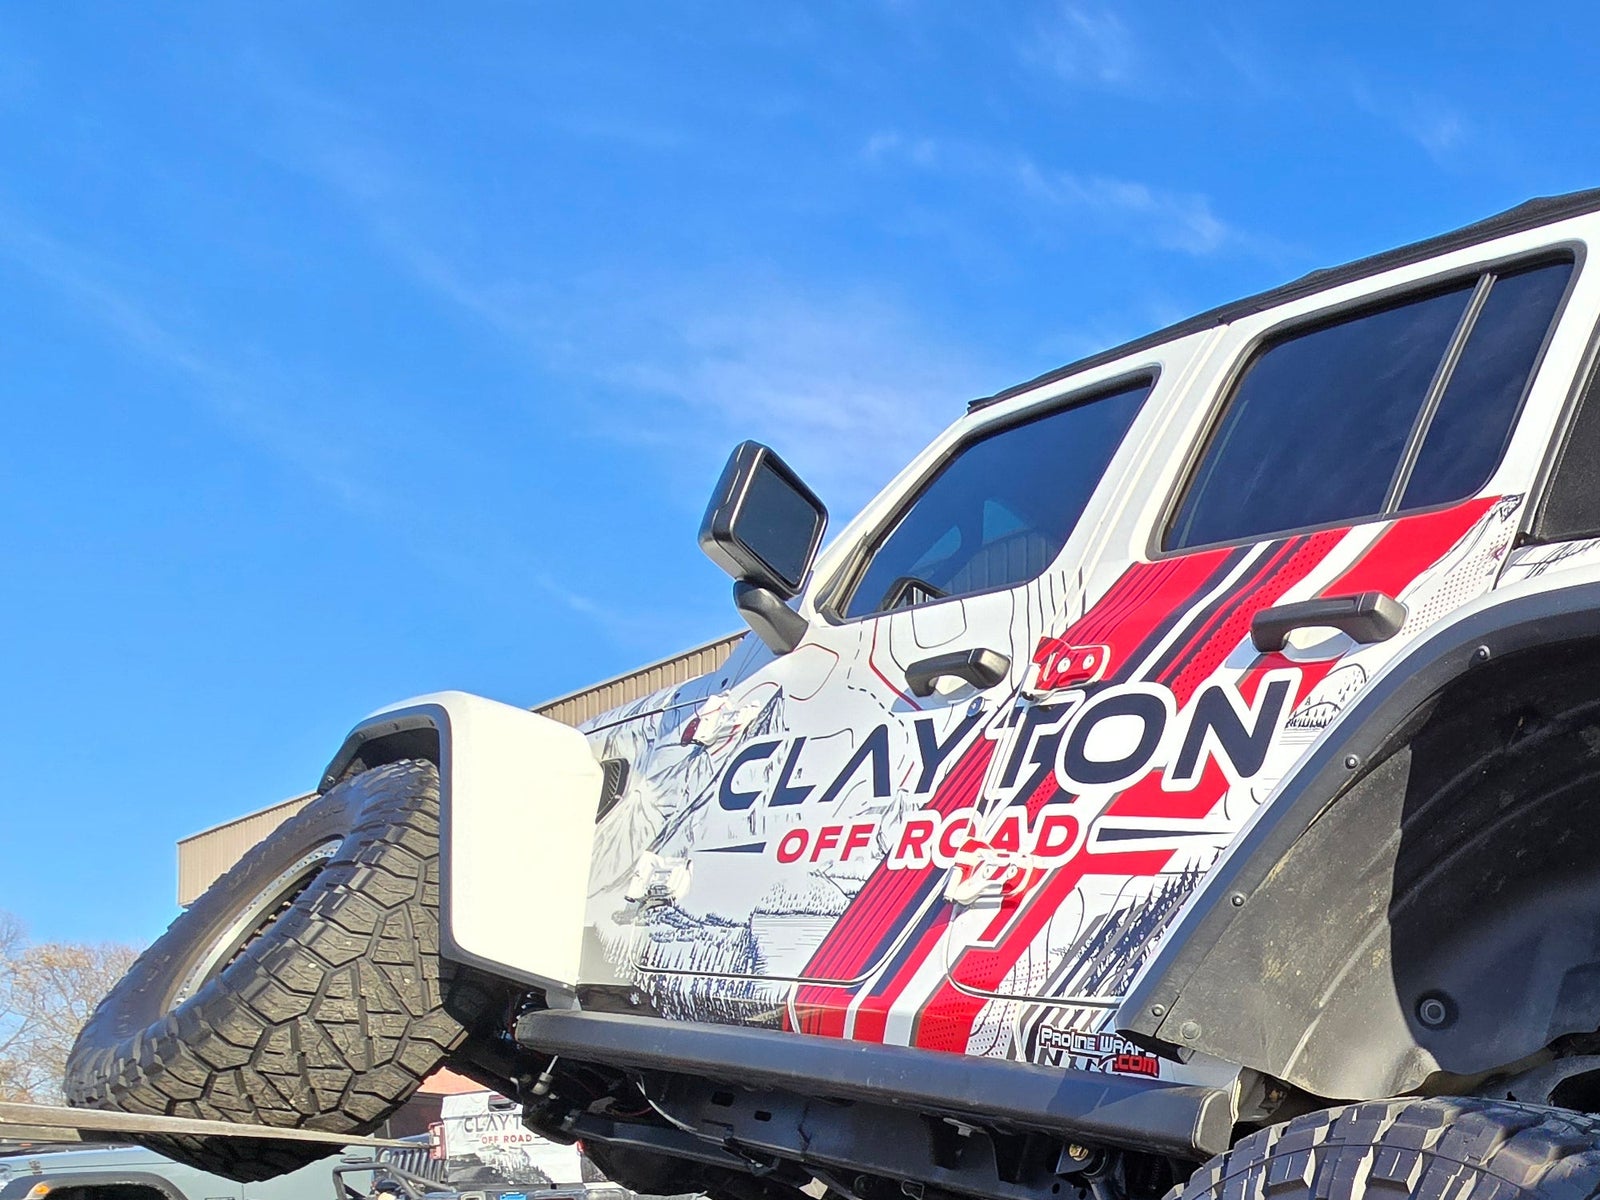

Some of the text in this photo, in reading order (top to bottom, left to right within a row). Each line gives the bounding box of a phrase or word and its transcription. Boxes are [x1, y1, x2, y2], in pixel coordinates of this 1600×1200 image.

[718, 678, 1292, 812] CLAYTON
[776, 813, 1080, 865] OFF ROAD
[481, 1134, 533, 1145] OFF ROAD
